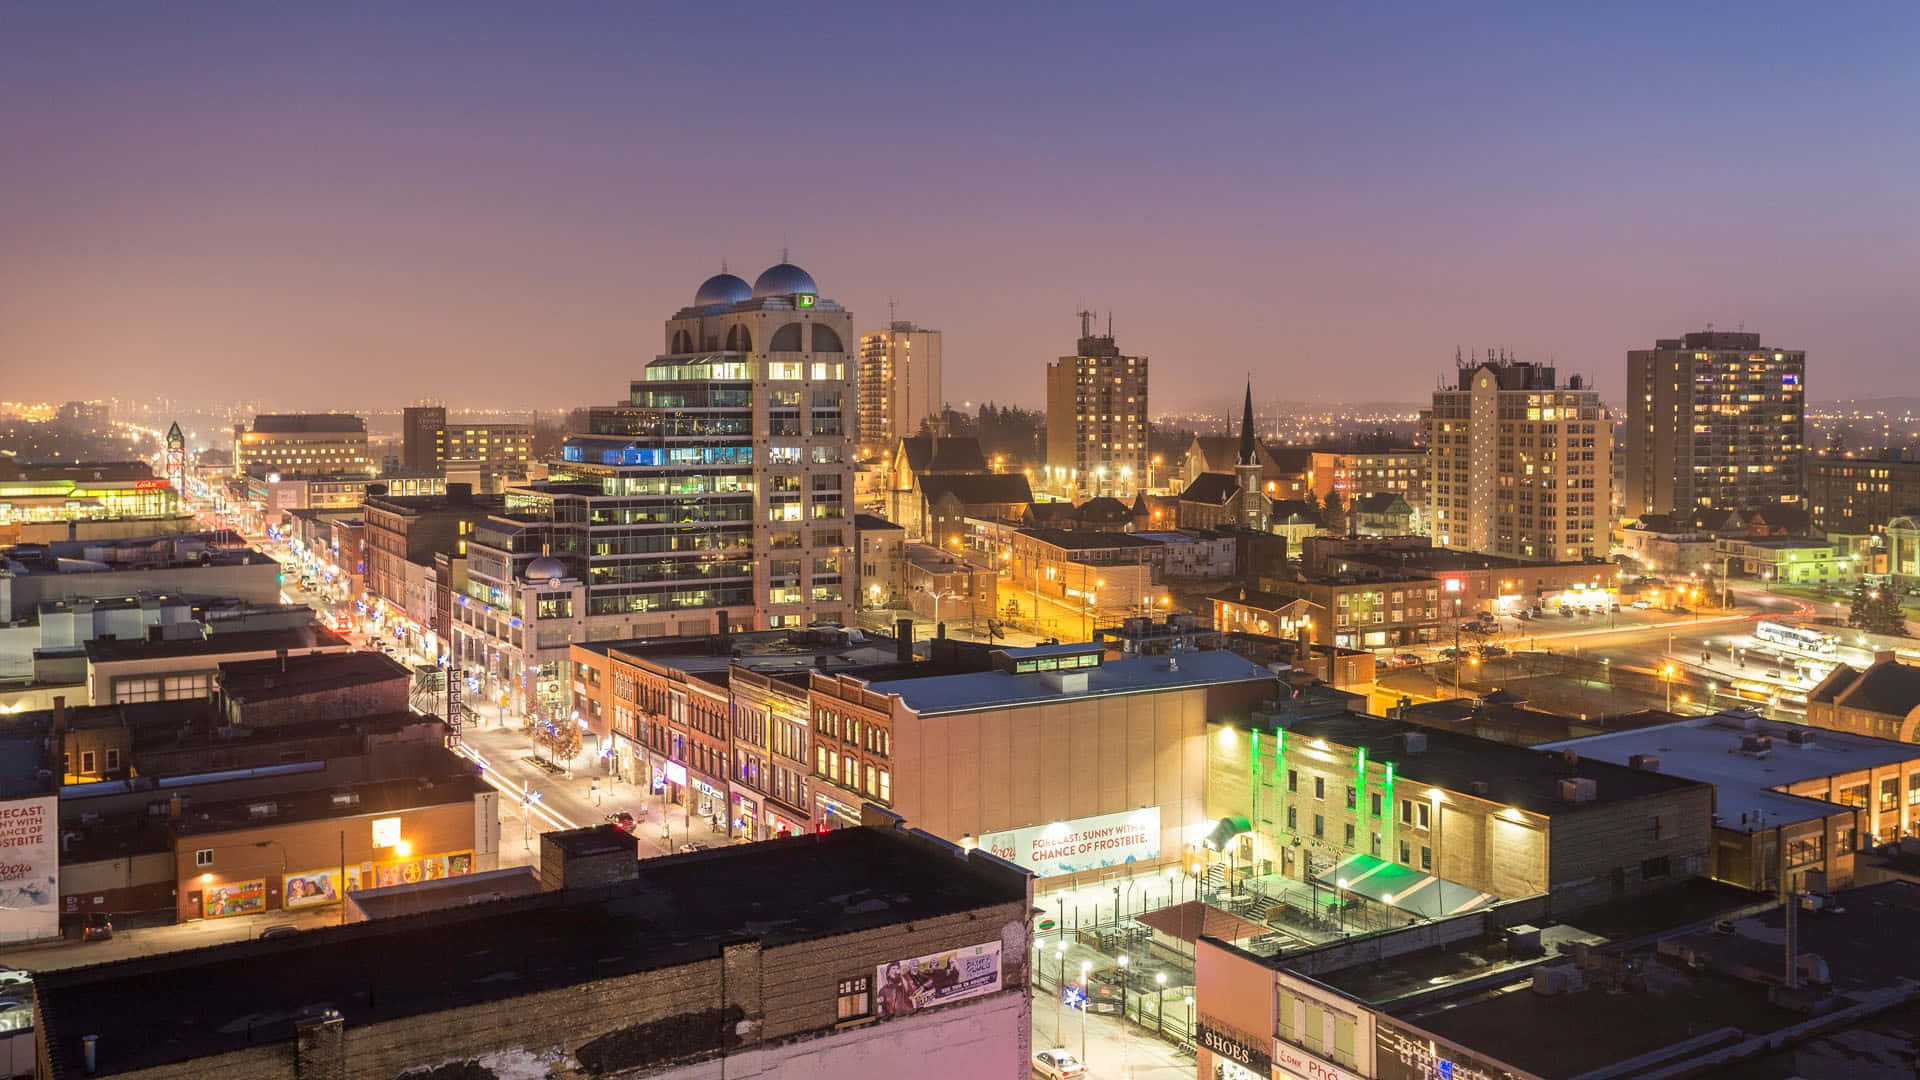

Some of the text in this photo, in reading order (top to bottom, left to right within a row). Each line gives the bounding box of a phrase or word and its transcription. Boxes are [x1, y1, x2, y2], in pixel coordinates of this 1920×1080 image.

[0, 806, 45, 819] ECAST:
[16, 817, 42, 826] WITH
[29, 825, 43, 834] OF
[1082, 828, 1114, 841] SUNNY
[1115, 824, 1138, 834] WITH
[0, 834, 44, 848] STBITE
[1031, 845, 1075, 862] CHANCE
[1078, 842, 1092, 854] OF
[1094, 833, 1148, 851] FROSTBITE.
[1204, 1031, 1249, 1064] SHOES
